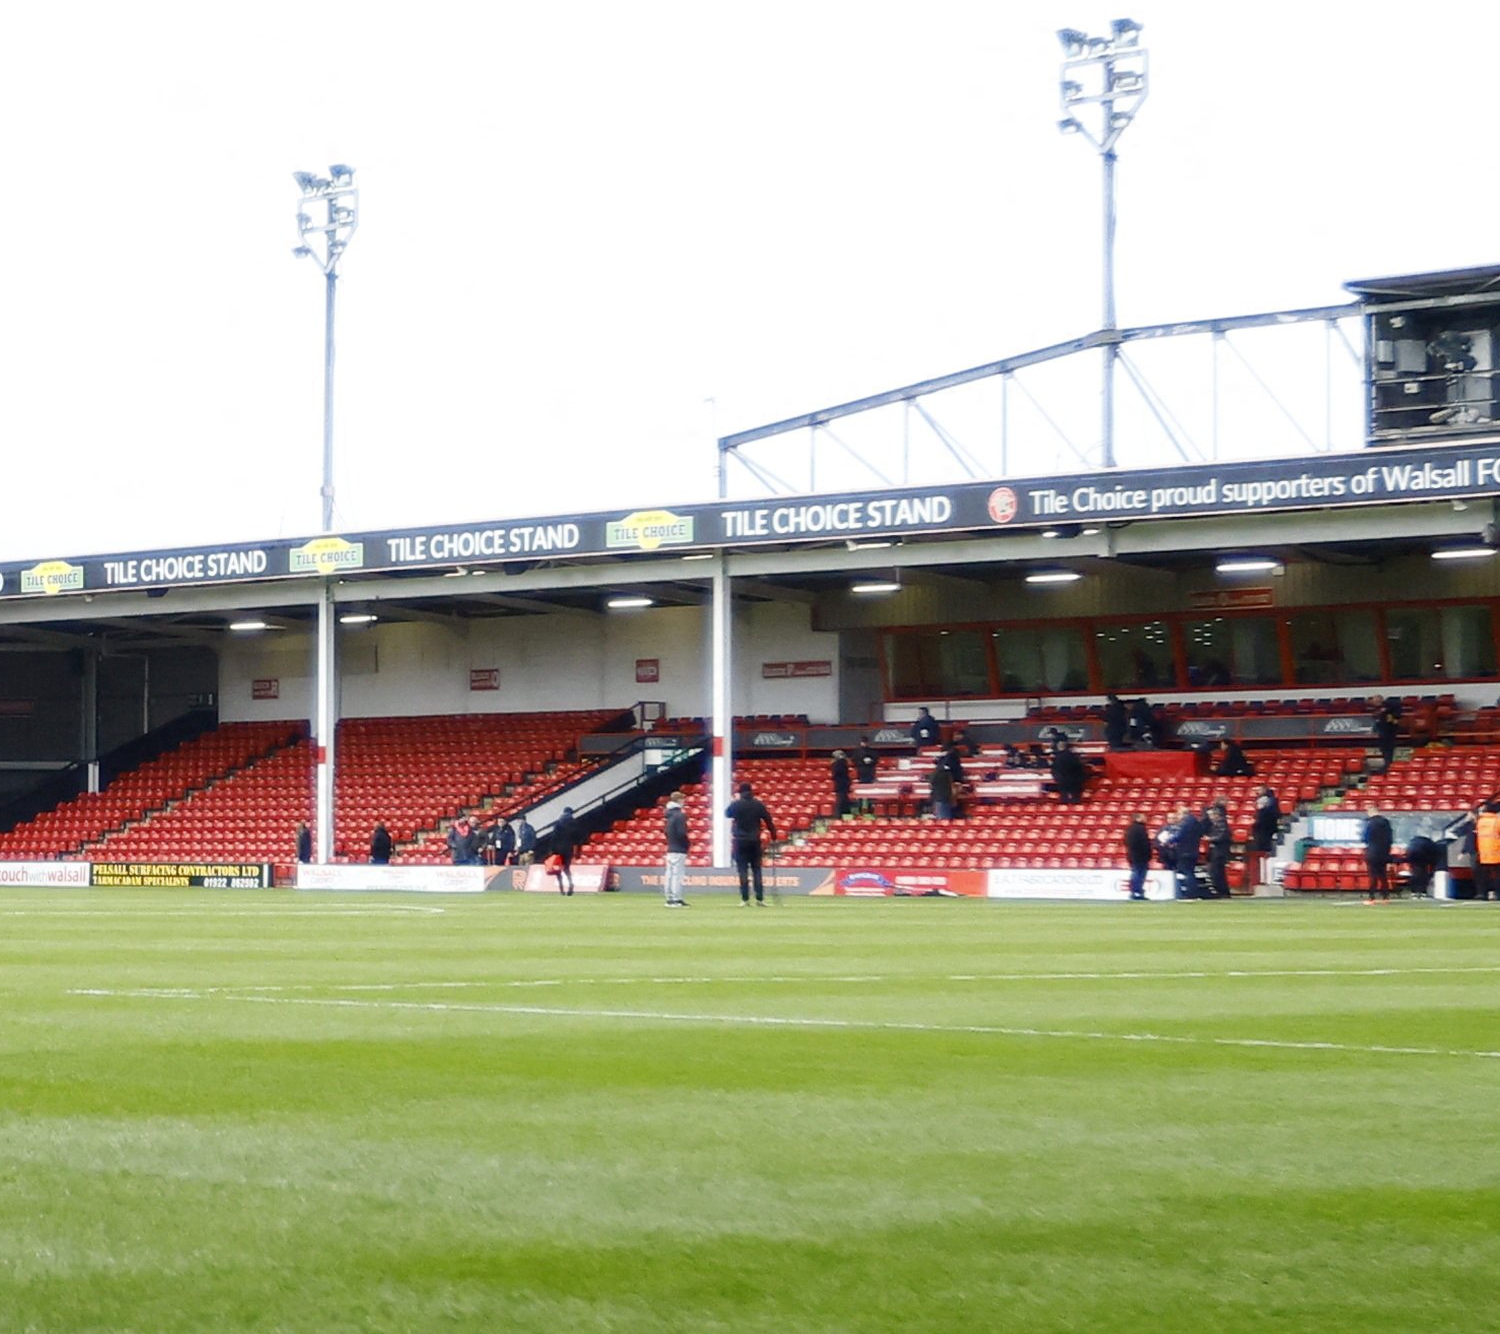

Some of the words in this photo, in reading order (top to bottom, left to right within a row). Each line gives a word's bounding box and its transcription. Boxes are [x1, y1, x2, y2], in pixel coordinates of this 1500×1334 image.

[1028, 488, 1069, 515] Tile
[1072, 485, 1148, 513] Choice
[1152, 477, 1217, 513] proud
[1222, 473, 1346, 507] supporters
[1351, 466, 1379, 494] of
[1382, 459, 1470, 492] Walsall
[721, 510, 769, 536] TILE
[772, 502, 863, 532] CHOICE
[867, 495, 951, 528] STAND
[613, 528, 639, 540] TILE
[643, 524, 686, 538] CHOICE
[387, 536, 426, 562] TILE
[430, 530, 506, 558] CHOICE
[508, 523, 579, 553] STAND
[296, 553, 317, 565] TILE
[320, 550, 357, 563] CHOICE
[104, 560, 138, 584] TILE
[140, 554, 205, 581] CHOICE
[208, 549, 267, 576] STAND
[26, 575, 45, 586] TILE
[47, 573, 78, 584] CHOICE
[92, 864, 128, 875] PELSALL
[129, 865, 177, 876] SURFACING
[178, 865, 239, 877] CONTRACTORS
[241, 866, 260, 877] LTD
[92, 875, 142, 886] TARMACADAM
[143, 876, 190, 887] SPECIALISTS
[203, 877, 227, 888] 01922
